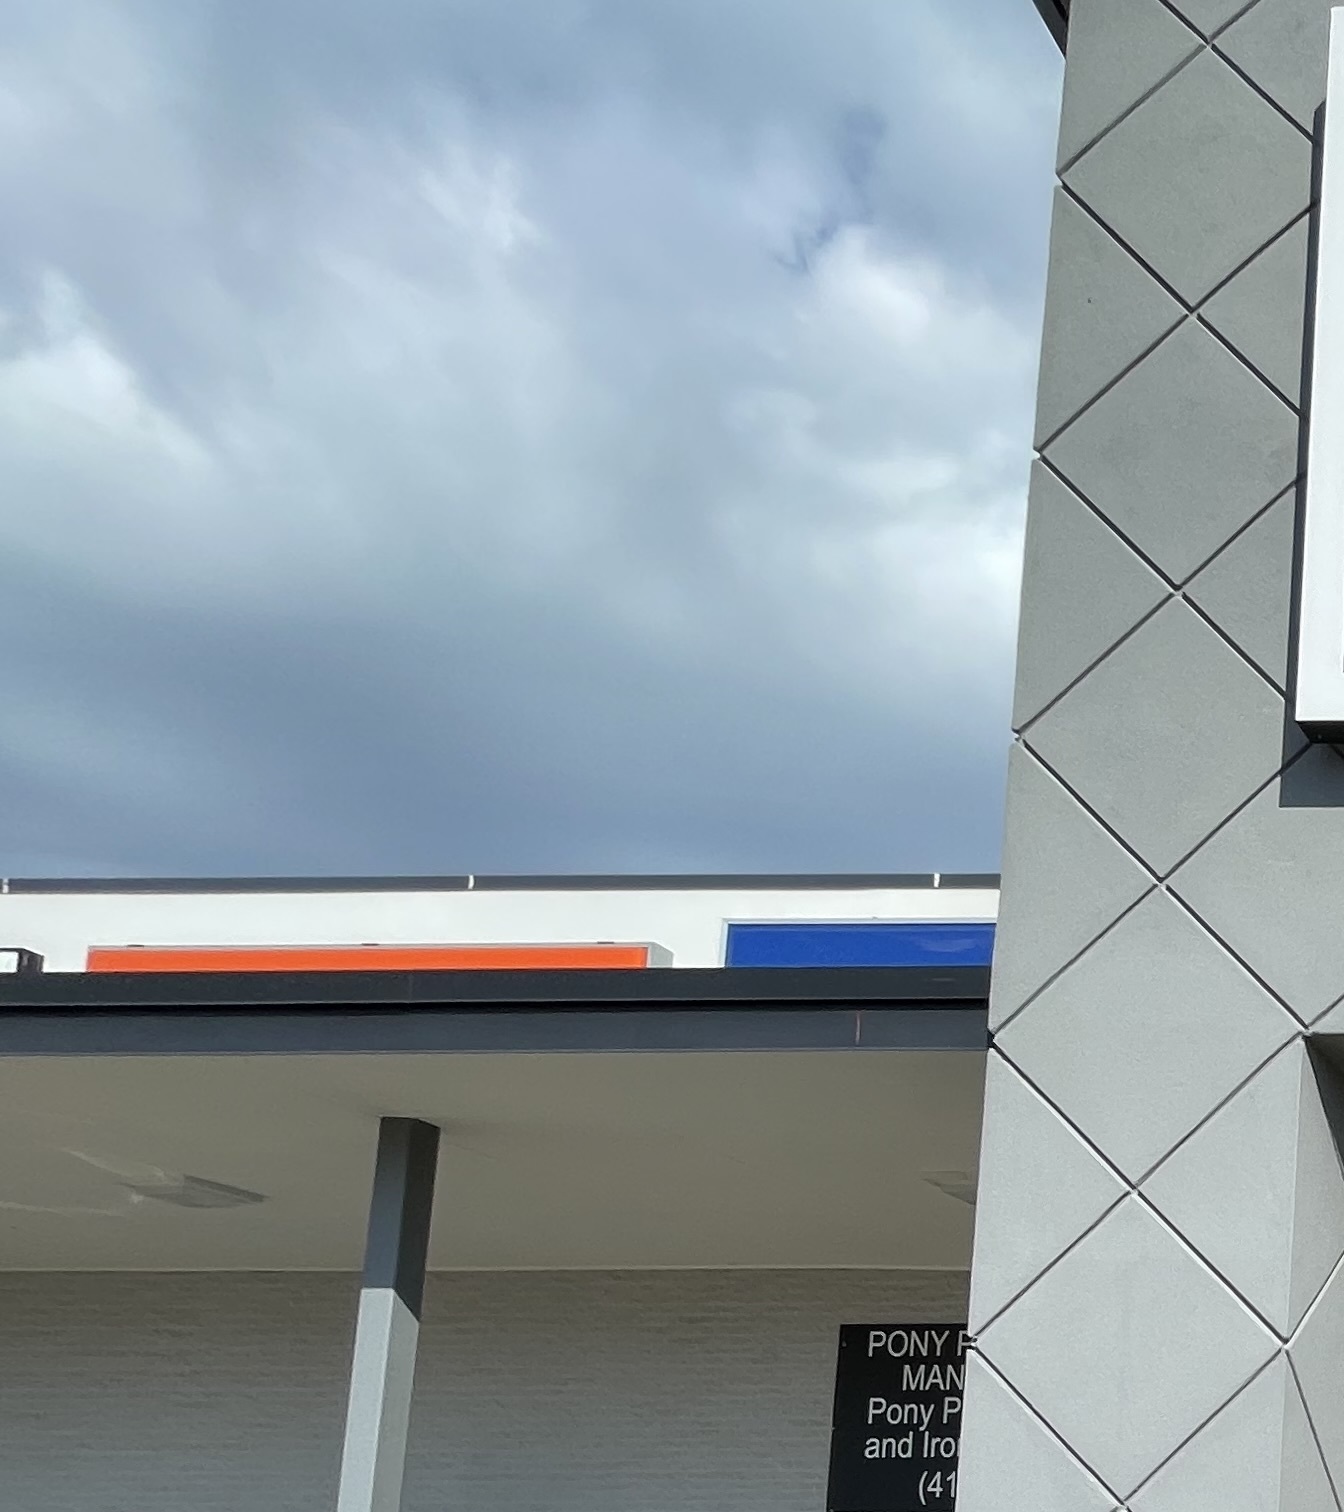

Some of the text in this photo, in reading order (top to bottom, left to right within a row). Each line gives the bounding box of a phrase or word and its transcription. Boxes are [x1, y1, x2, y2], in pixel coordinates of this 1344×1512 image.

[868, 1330, 949, 1357] PONY
[867, 1397, 935, 1431] Pony
[864, 1431, 960, 1458] and Iro
